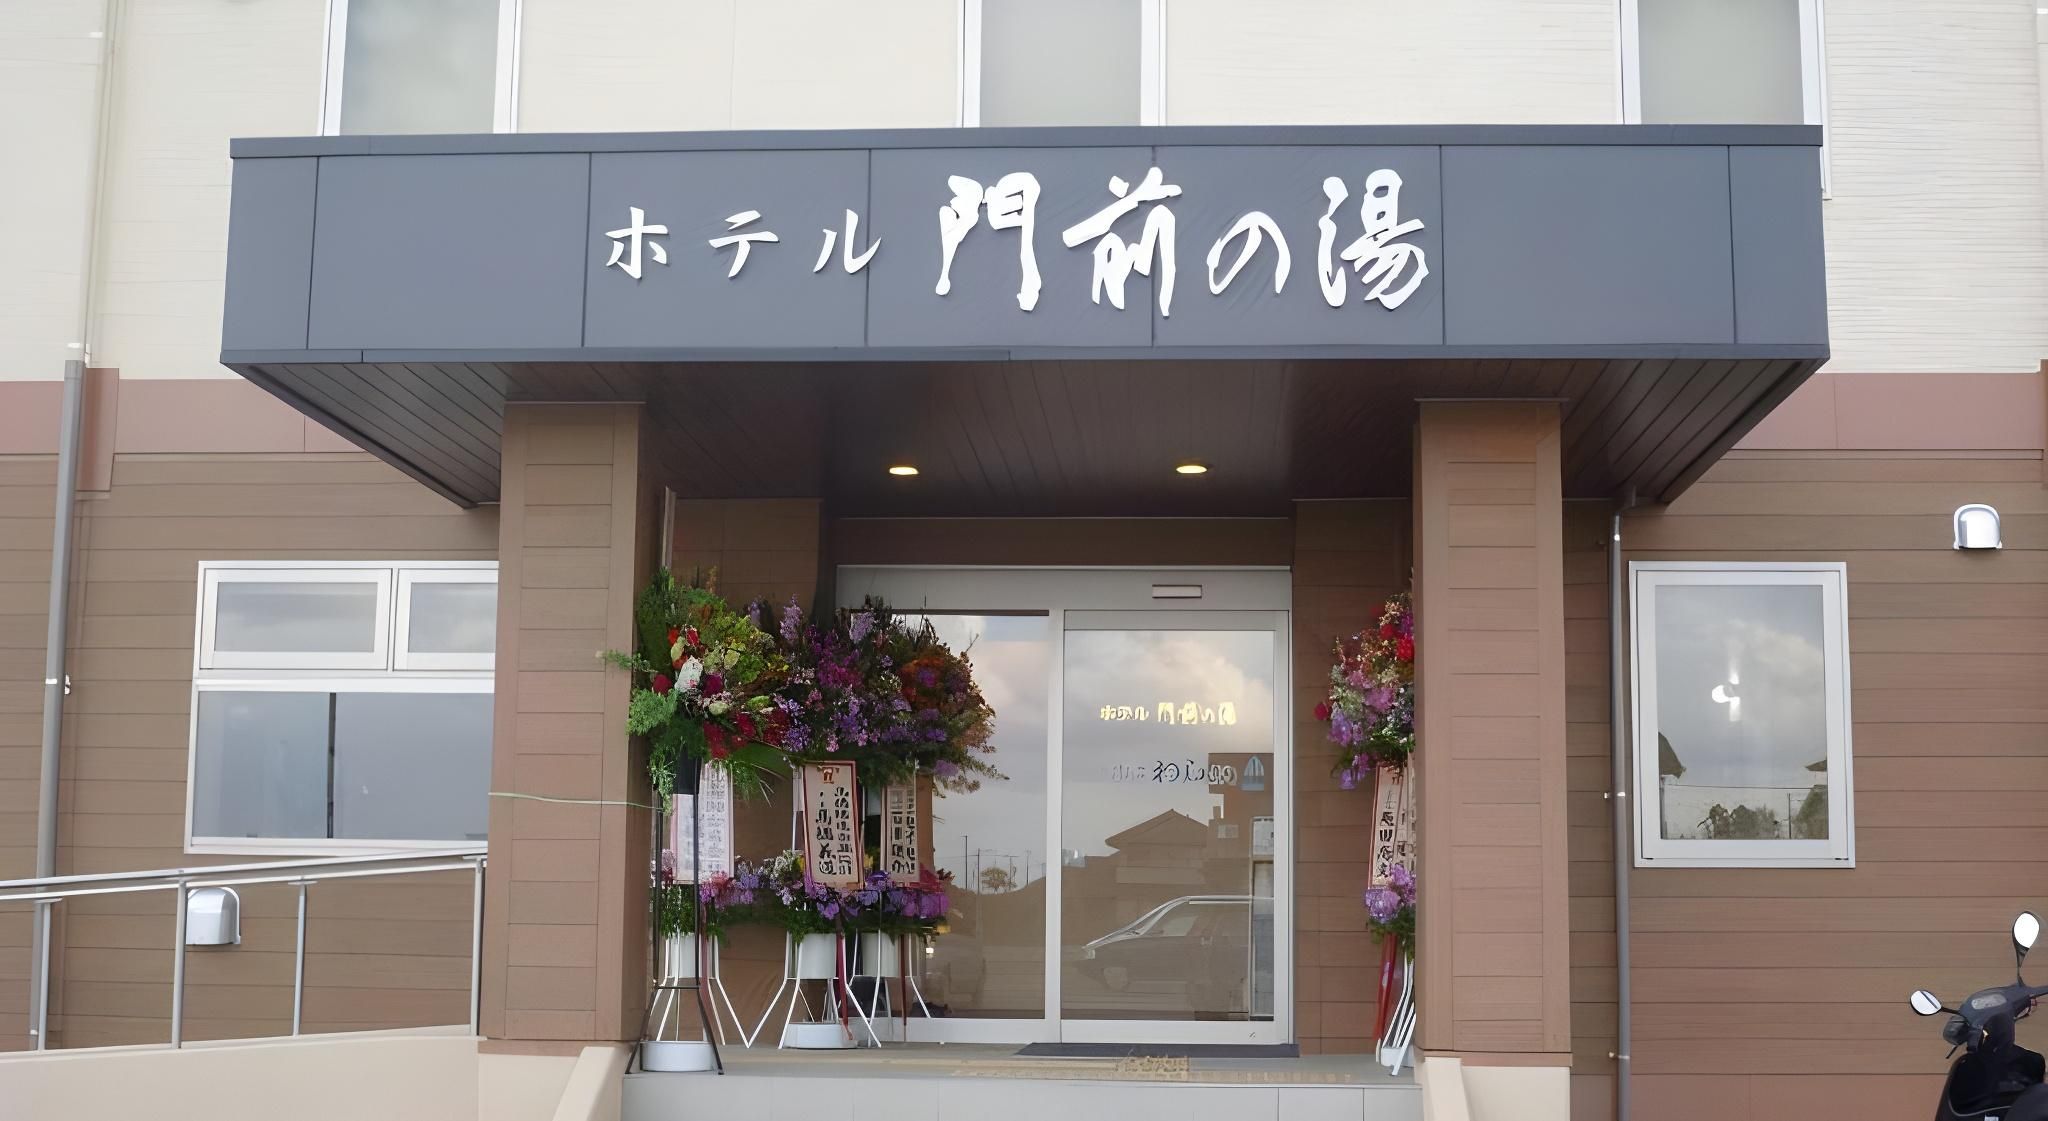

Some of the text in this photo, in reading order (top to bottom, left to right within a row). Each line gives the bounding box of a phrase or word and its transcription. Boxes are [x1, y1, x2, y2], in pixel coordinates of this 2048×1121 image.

[604, 166, 1429, 317] ホテル 門前の湯
